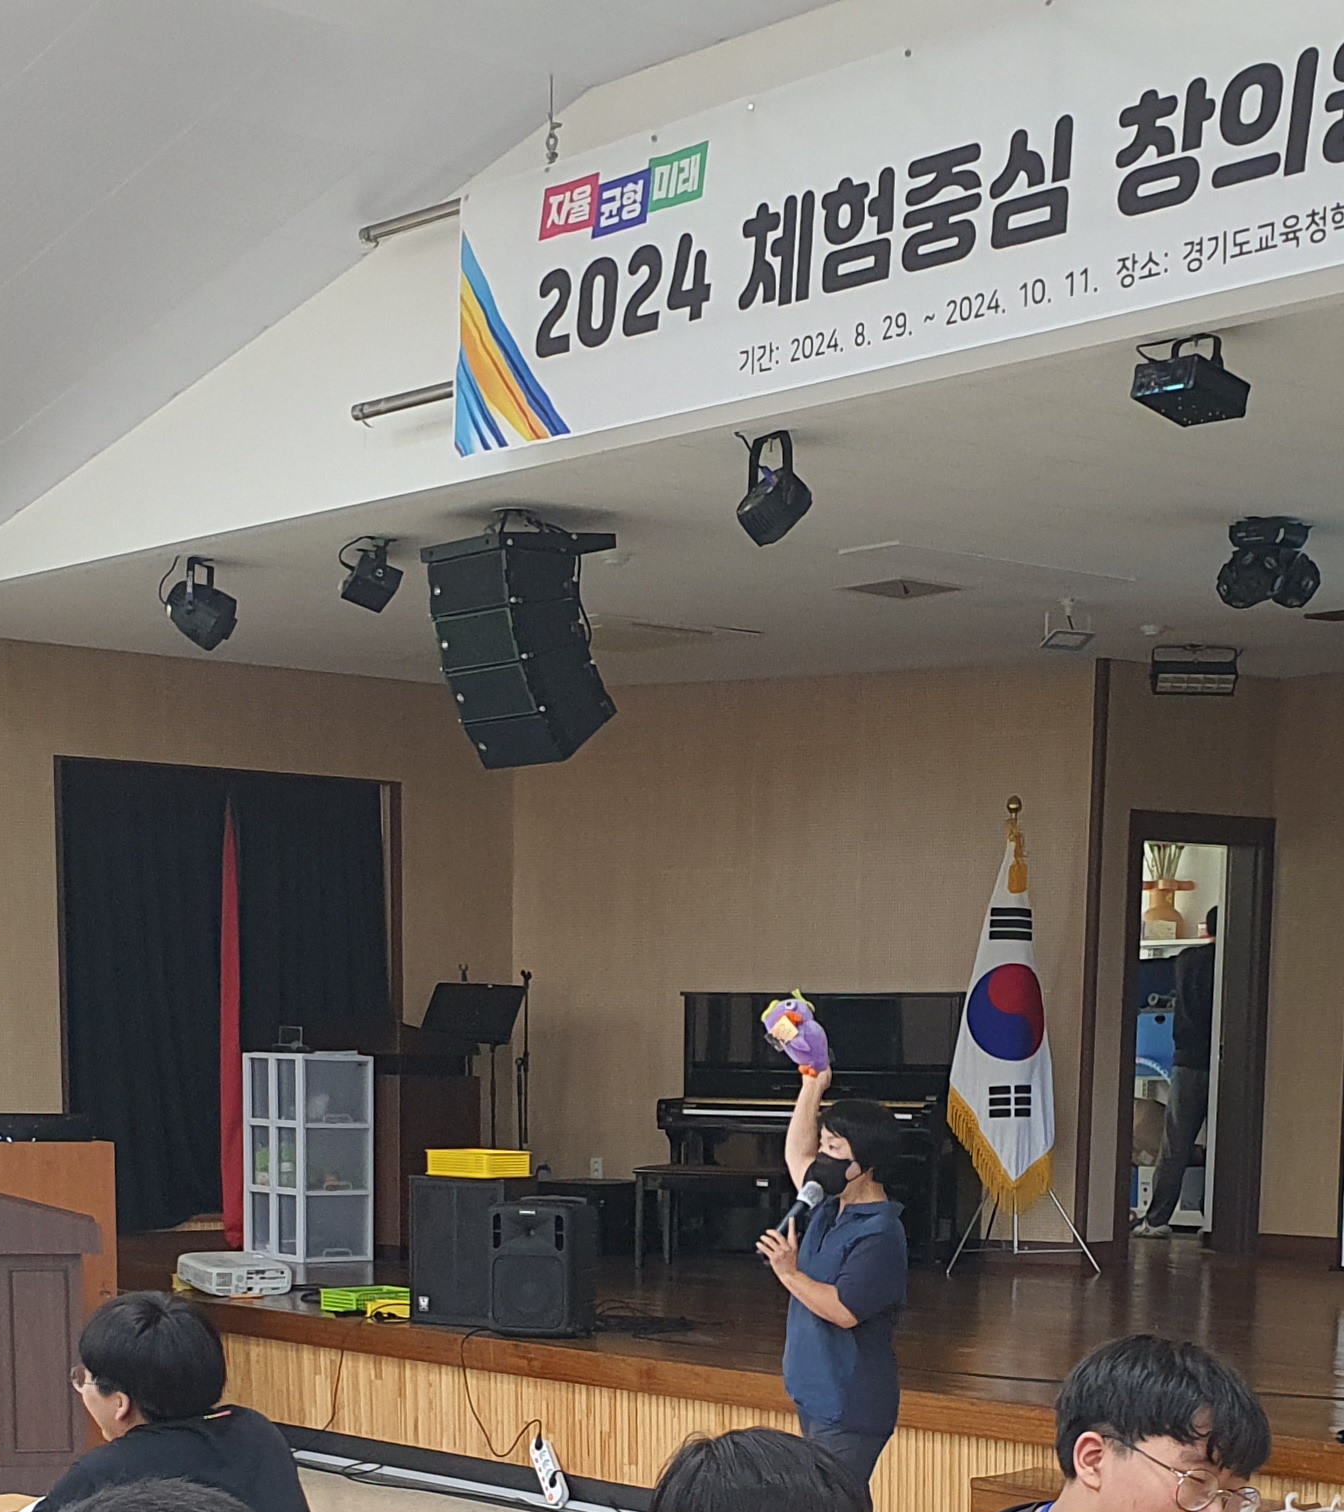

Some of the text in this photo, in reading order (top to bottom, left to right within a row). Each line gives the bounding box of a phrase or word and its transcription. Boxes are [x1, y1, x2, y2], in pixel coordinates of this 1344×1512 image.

[536, 232, 712, 359] 2024
[738, 113, 1074, 311] 체험중심
[546, 153, 701, 229] 자율 균형 미래
[738, 341, 780, 375] 기간:
[789, 328, 844, 363] 2024.
[854, 322, 872, 347] 8.
[881, 312, 913, 341] 29.
[945, 288, 1006, 326] 2024.
[1018, 278, 1052, 307] 10.
[1064, 267, 1099, 297] 11.
[1116, 251, 1169, 289] 장소:
